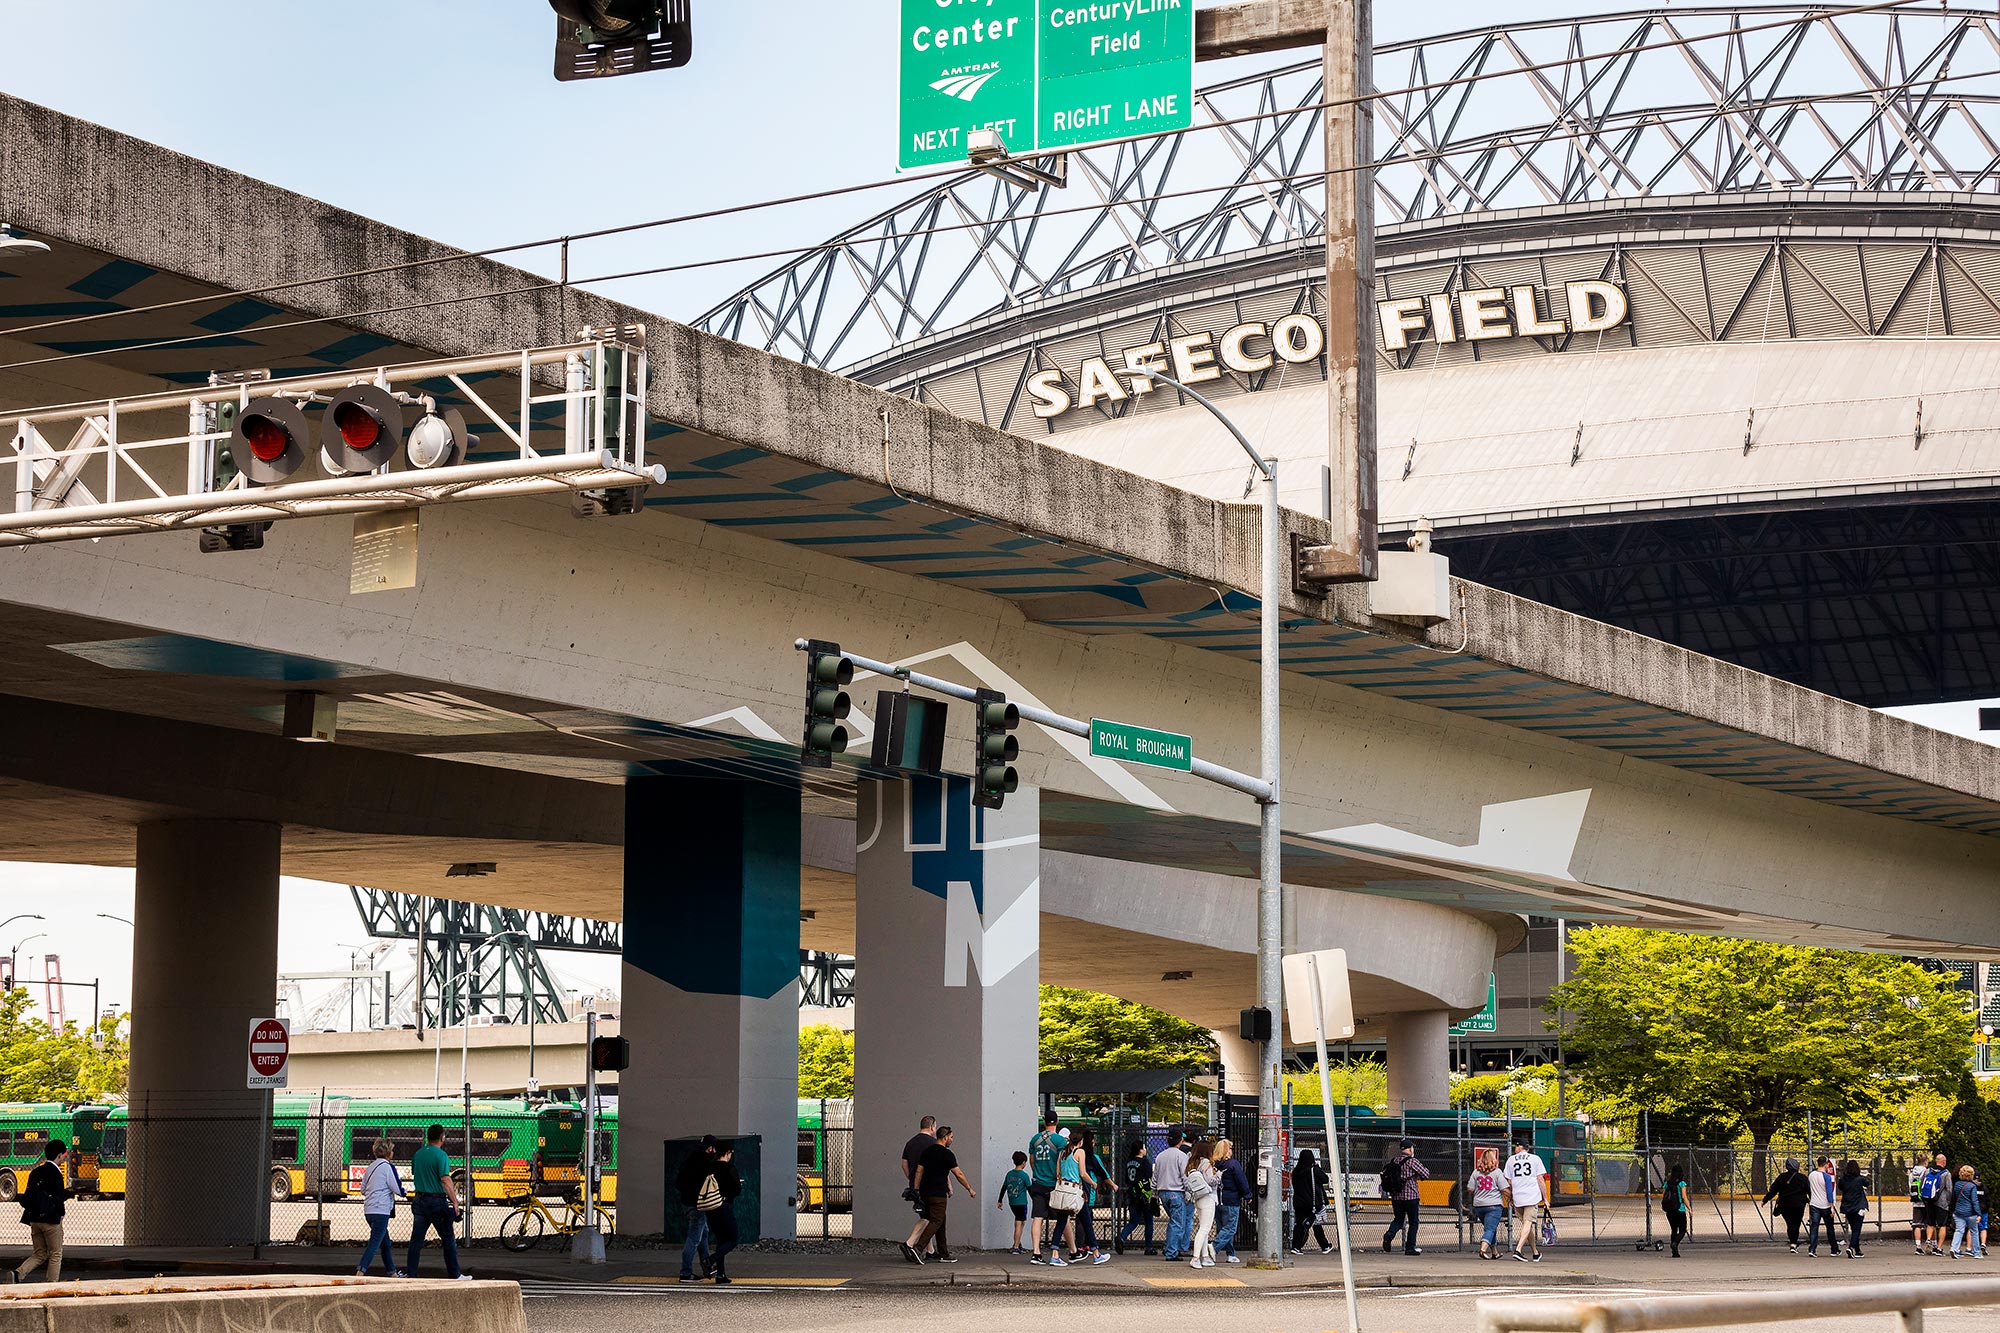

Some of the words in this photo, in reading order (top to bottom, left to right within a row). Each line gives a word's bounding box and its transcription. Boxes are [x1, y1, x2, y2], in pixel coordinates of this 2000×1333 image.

[913, 17, 1019, 51] Center
[1091, 30, 1140, 56] Field
[941, 61, 1000, 76] AMTRAK
[1054, 104, 1112, 131] RIGHT
[1124, 94, 1178, 121] LANE
[914, 127, 960, 152] NEXT
[973, 119, 1017, 138] FT
[1026, 312, 1325, 419] SAFECO
[1377, 280, 1629, 351] FIELD
[1099, 731, 1129, 750] ROYAL
[1136, 738, 1184, 760] BROUGHAM
[1473, 1020, 1478, 1029] 2
[257, 1030, 267, 1040] DO
[269, 1030, 282, 1040] NOT
[257, 1056, 280, 1065] ENTER
[1036, 1145, 1051, 1160] 22
[1513, 1162, 1532, 1177] 23
[1476, 1175, 1493, 1191] 38
